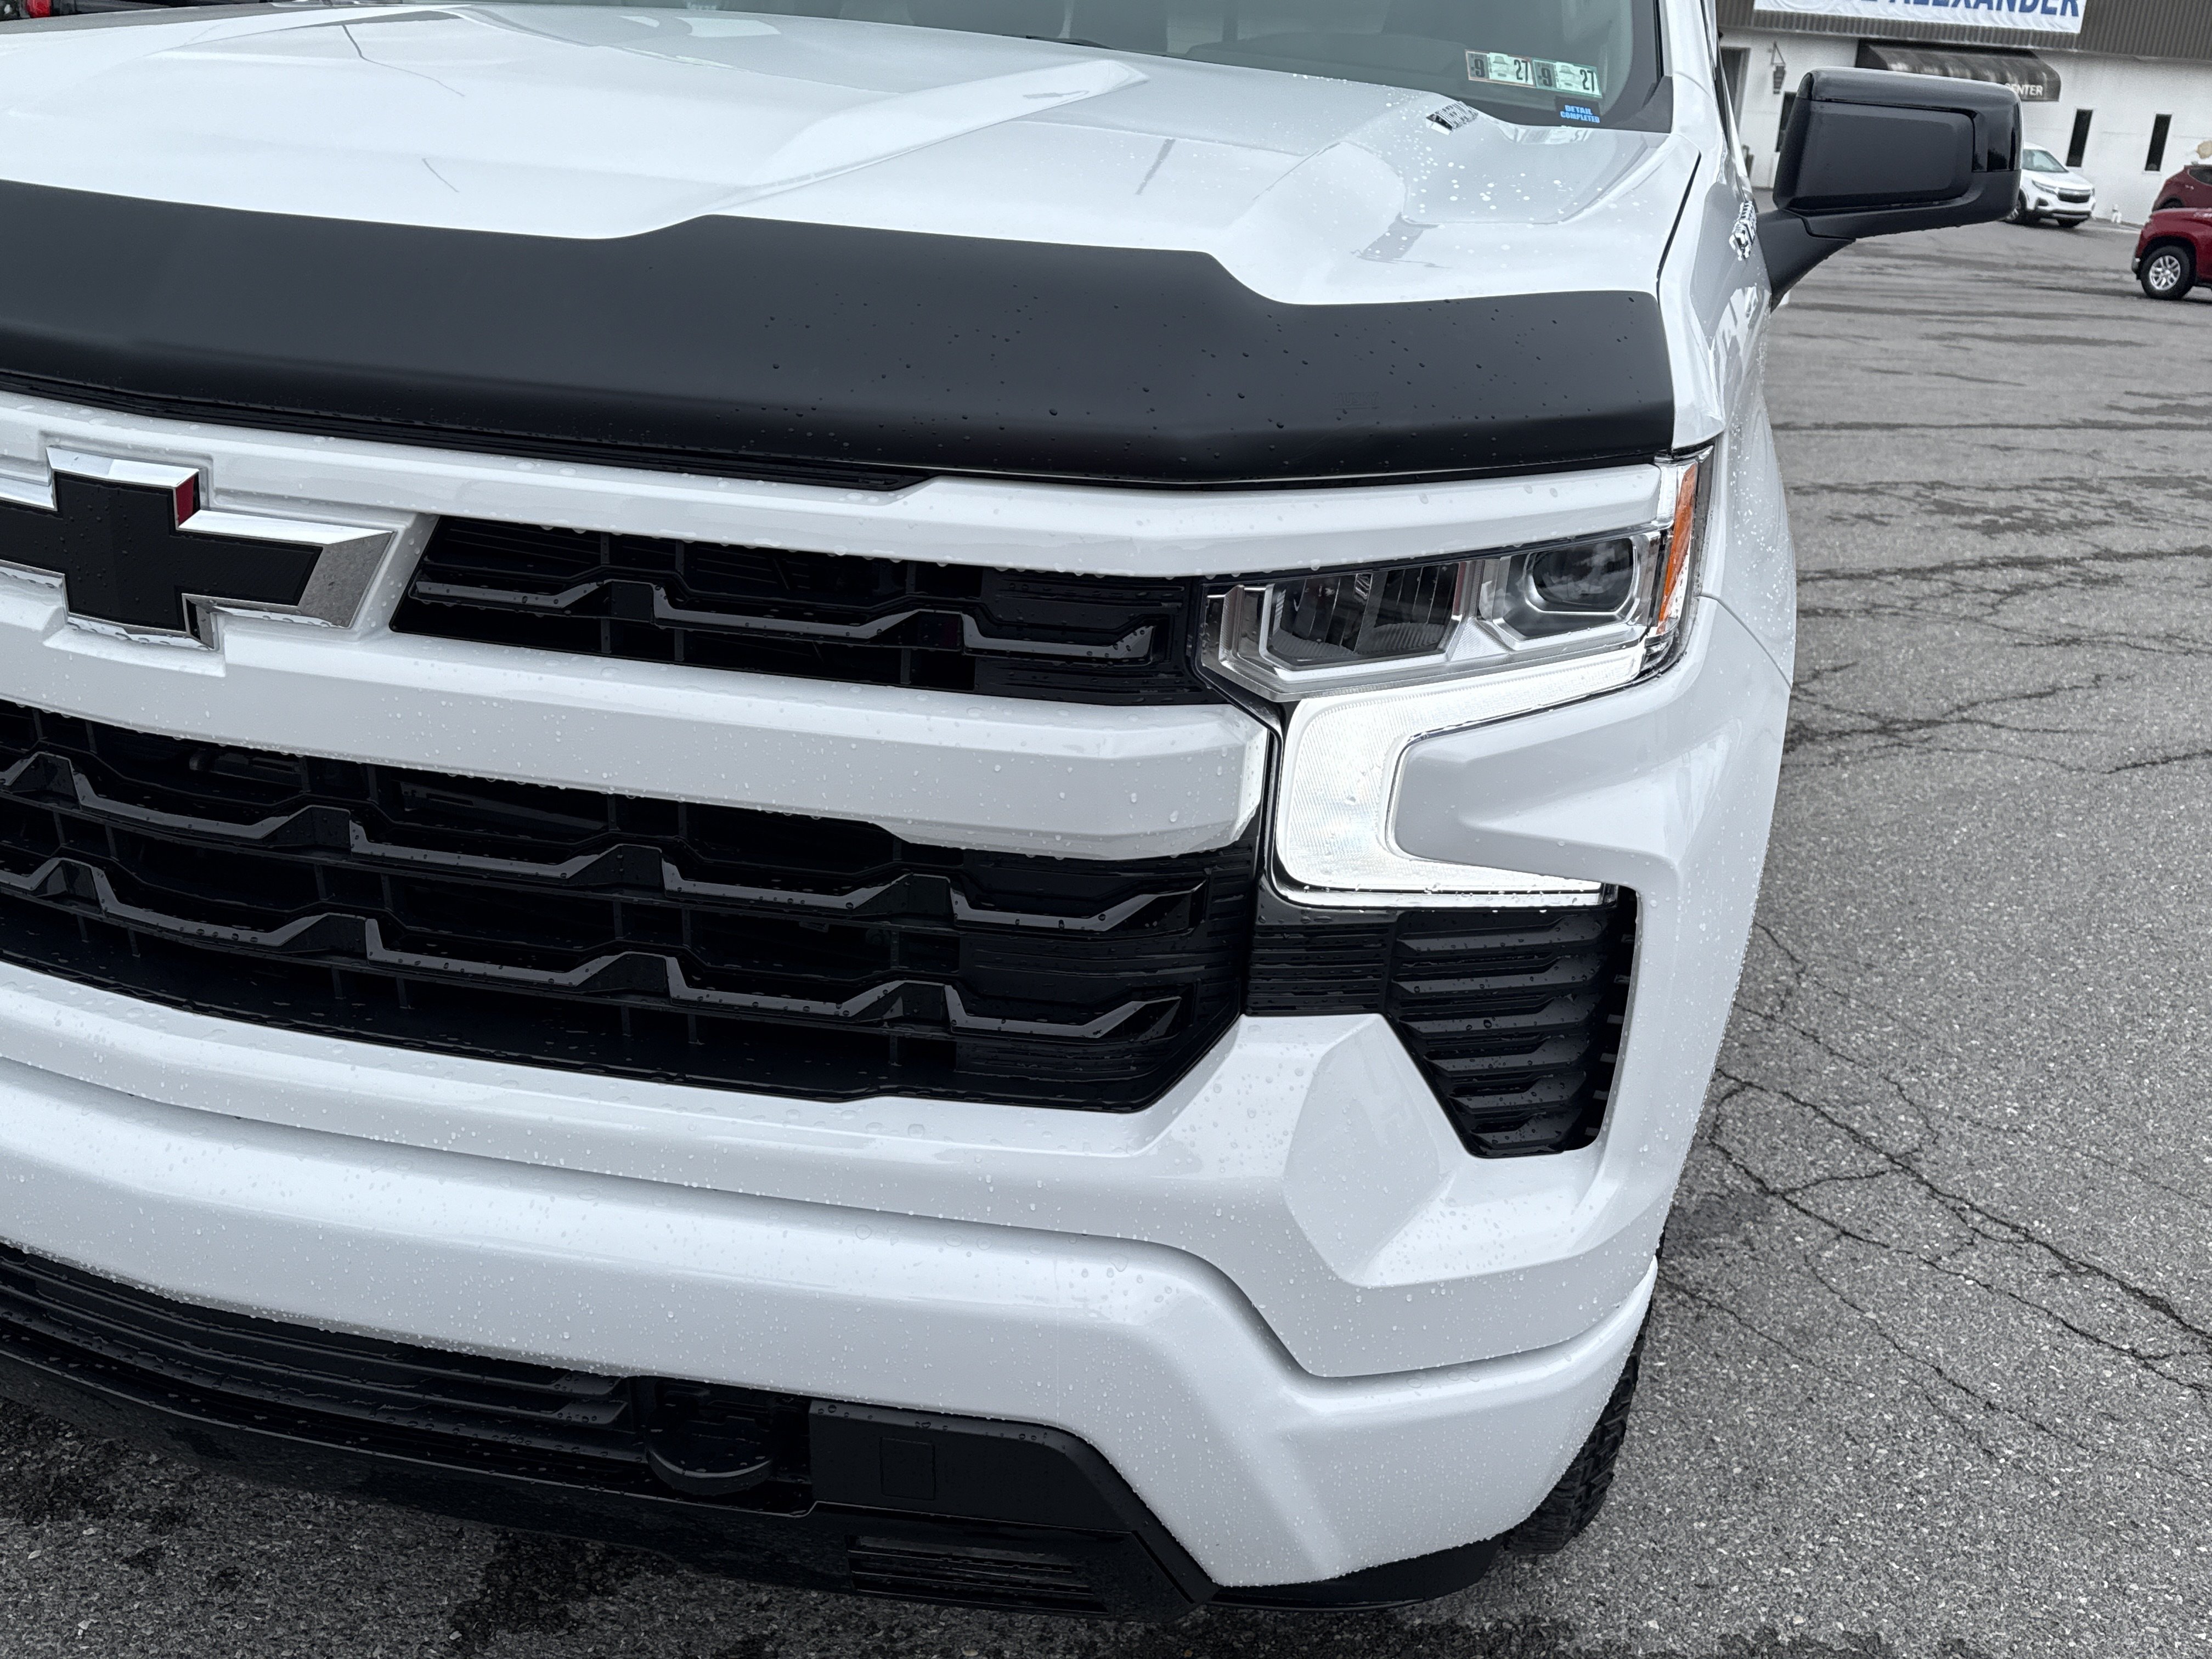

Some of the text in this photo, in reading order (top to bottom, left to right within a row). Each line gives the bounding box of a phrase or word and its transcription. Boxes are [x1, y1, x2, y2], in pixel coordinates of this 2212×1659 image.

[1475, 59, 1528, 83] 9 27
[1542, 67, 1595, 93] 9 27
[1560, 111, 1600, 123] COMPLETED
[1565, 105, 1593, 115] DETAIL
